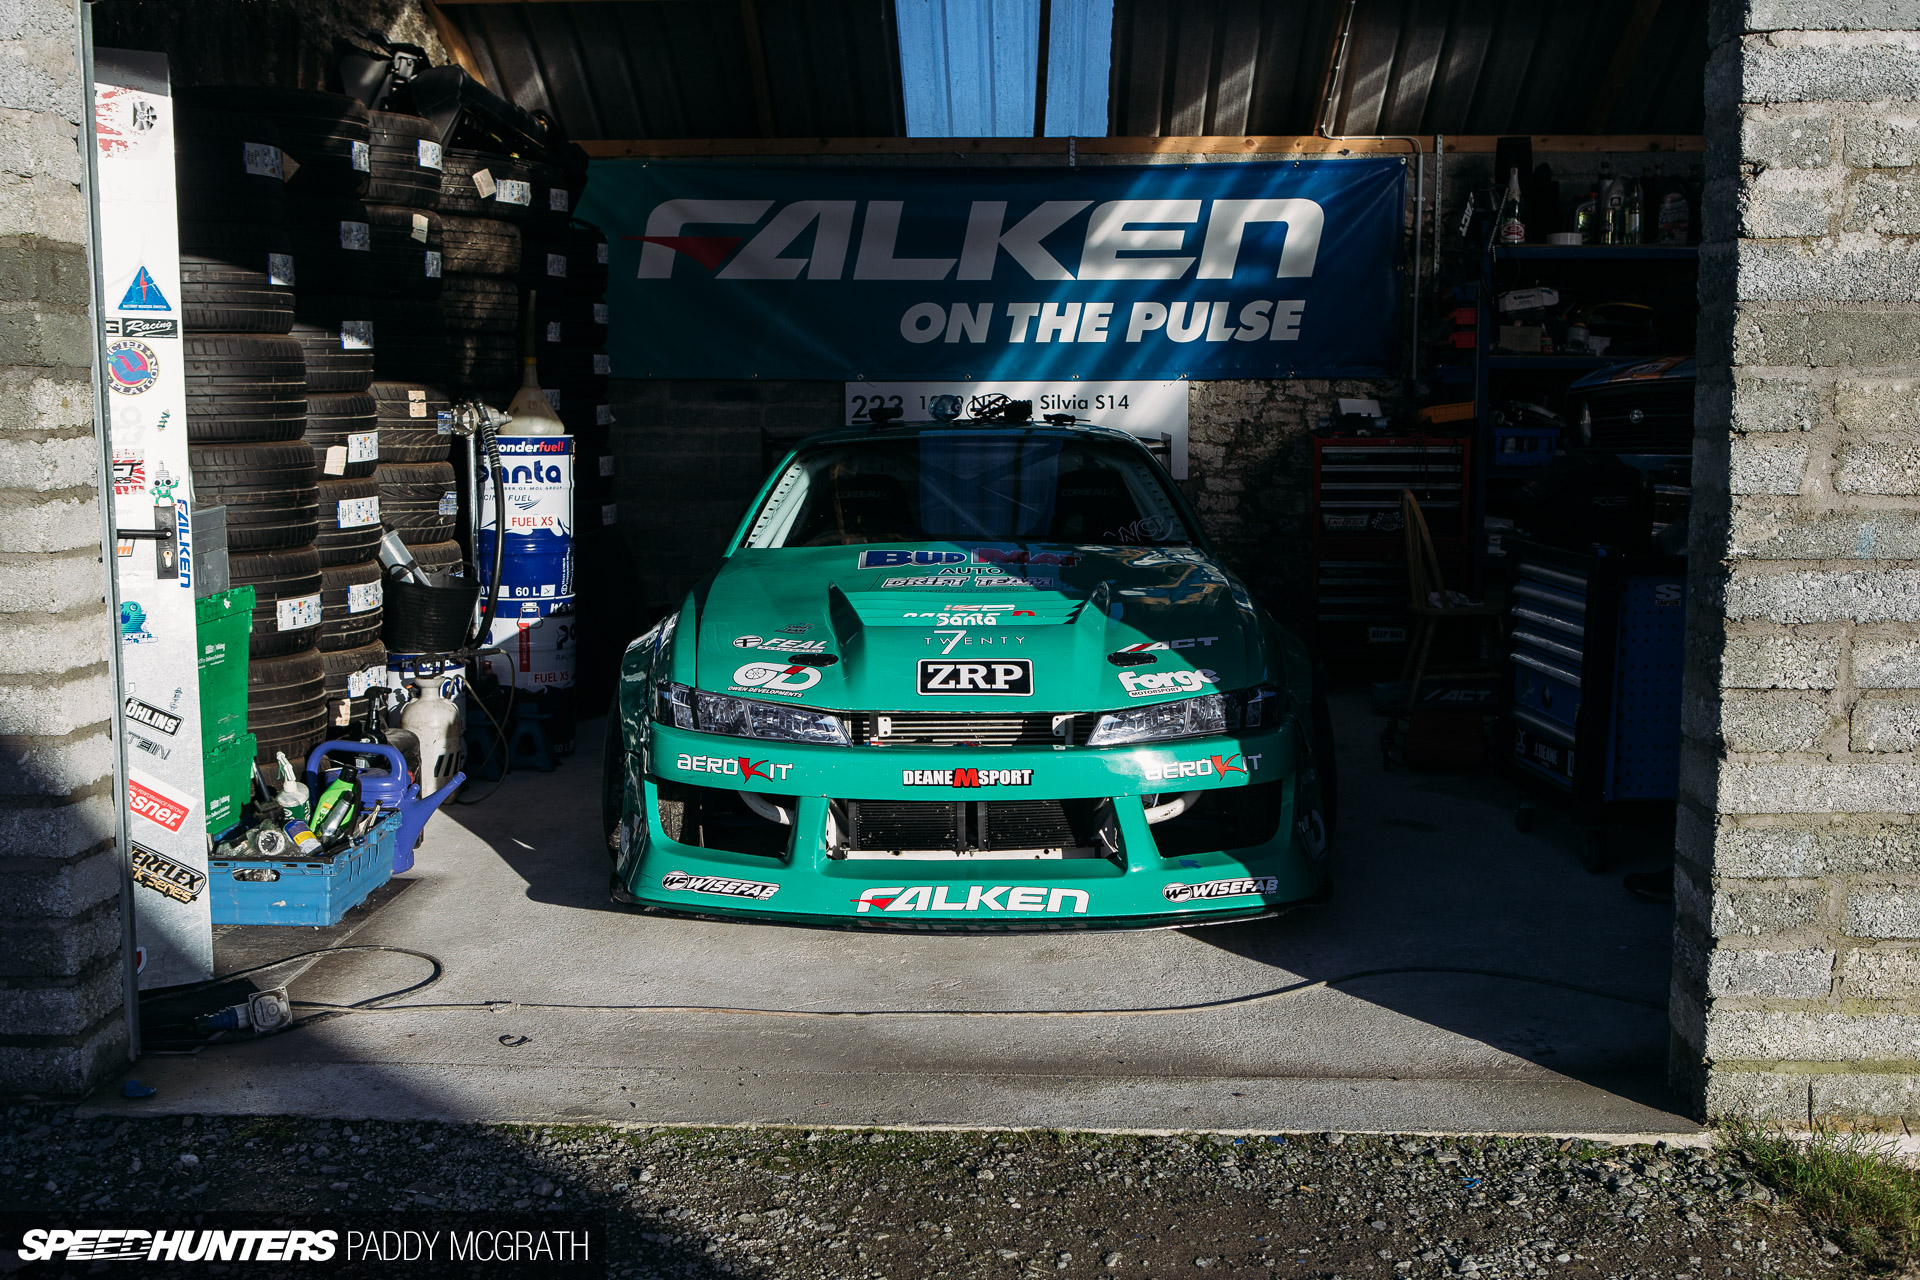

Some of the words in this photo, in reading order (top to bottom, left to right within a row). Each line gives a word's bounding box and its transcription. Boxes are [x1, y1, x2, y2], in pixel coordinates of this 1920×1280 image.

[636, 198, 1325, 281] FALKEN
[125, 320, 173, 333] Racing
[900, 302, 993, 343] ON
[1006, 301, 1113, 343] THE
[1125, 299, 1306, 342] PULSE
[1040, 394, 1089, 410] Silvia
[1095, 394, 1129, 410] S14
[496, 441, 564, 453] onderfuel!
[511, 516, 538, 527] FUEL
[540, 516, 553, 526] XS
[177, 498, 191, 589] FALKEN
[938, 567, 1005, 575] AUTO
[881, 576, 970, 588] DRIFT
[975, 576, 1054, 588] TEAM
[515, 586, 530, 597] 60
[532, 586, 540, 597] L
[762, 637, 829, 650] FEAL
[924, 636, 1026, 646] TWENTY
[534, 673, 557, 683] FUEL
[559, 671, 569, 681] XS
[927, 664, 1023, 690] ZRP
[1117, 668, 1221, 693] Forge
[748, 687, 804, 698] DEVELOPMENTS
[1131, 687, 1180, 696] MOTORSPORT
[126, 699, 178, 733] ÖHLINS
[677, 753, 793, 784] AEROKIT
[687, 877, 780, 898] WISEFAB
[1192, 879, 1279, 898] WISEFAB
[853, 884, 1090, 914] FALKEN
